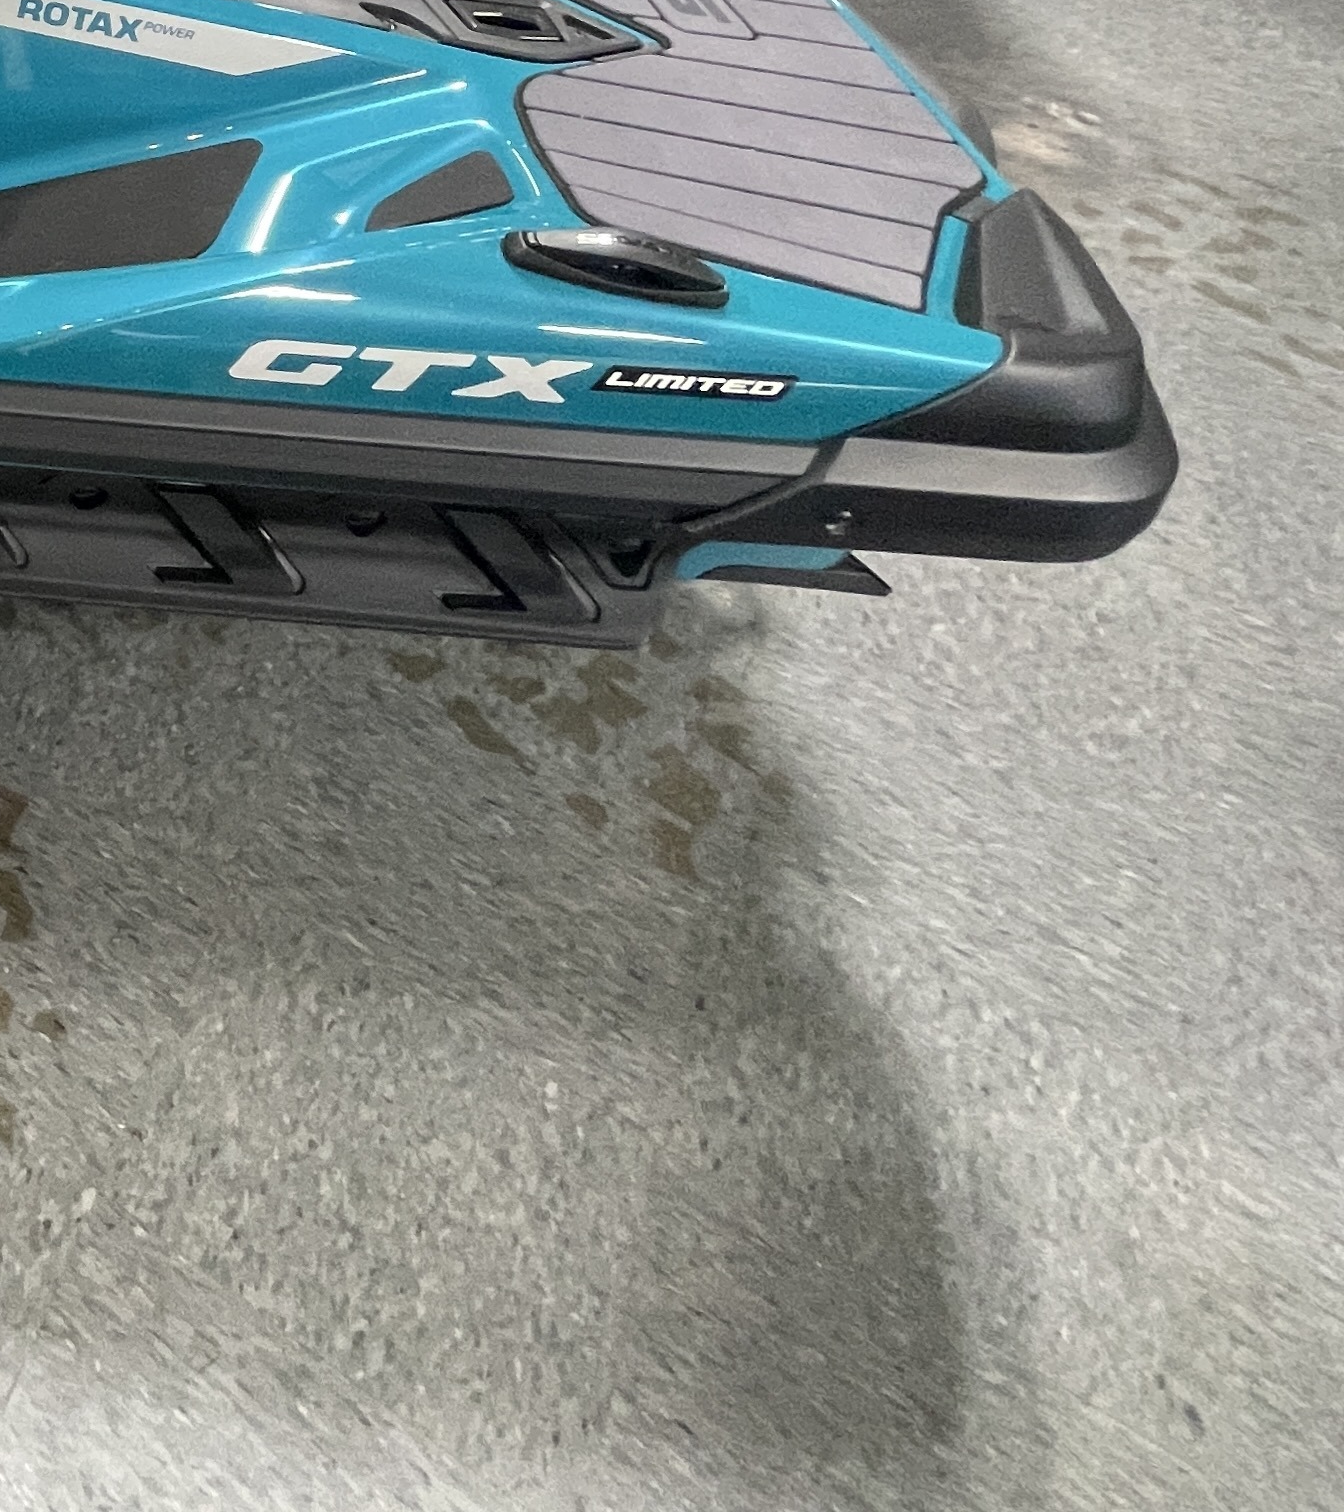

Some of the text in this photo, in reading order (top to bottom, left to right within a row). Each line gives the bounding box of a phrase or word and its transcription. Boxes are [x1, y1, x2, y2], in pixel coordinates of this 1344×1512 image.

[144, 20, 195, 42] POWER
[228, 339, 787, 404] GTX LIMITED
